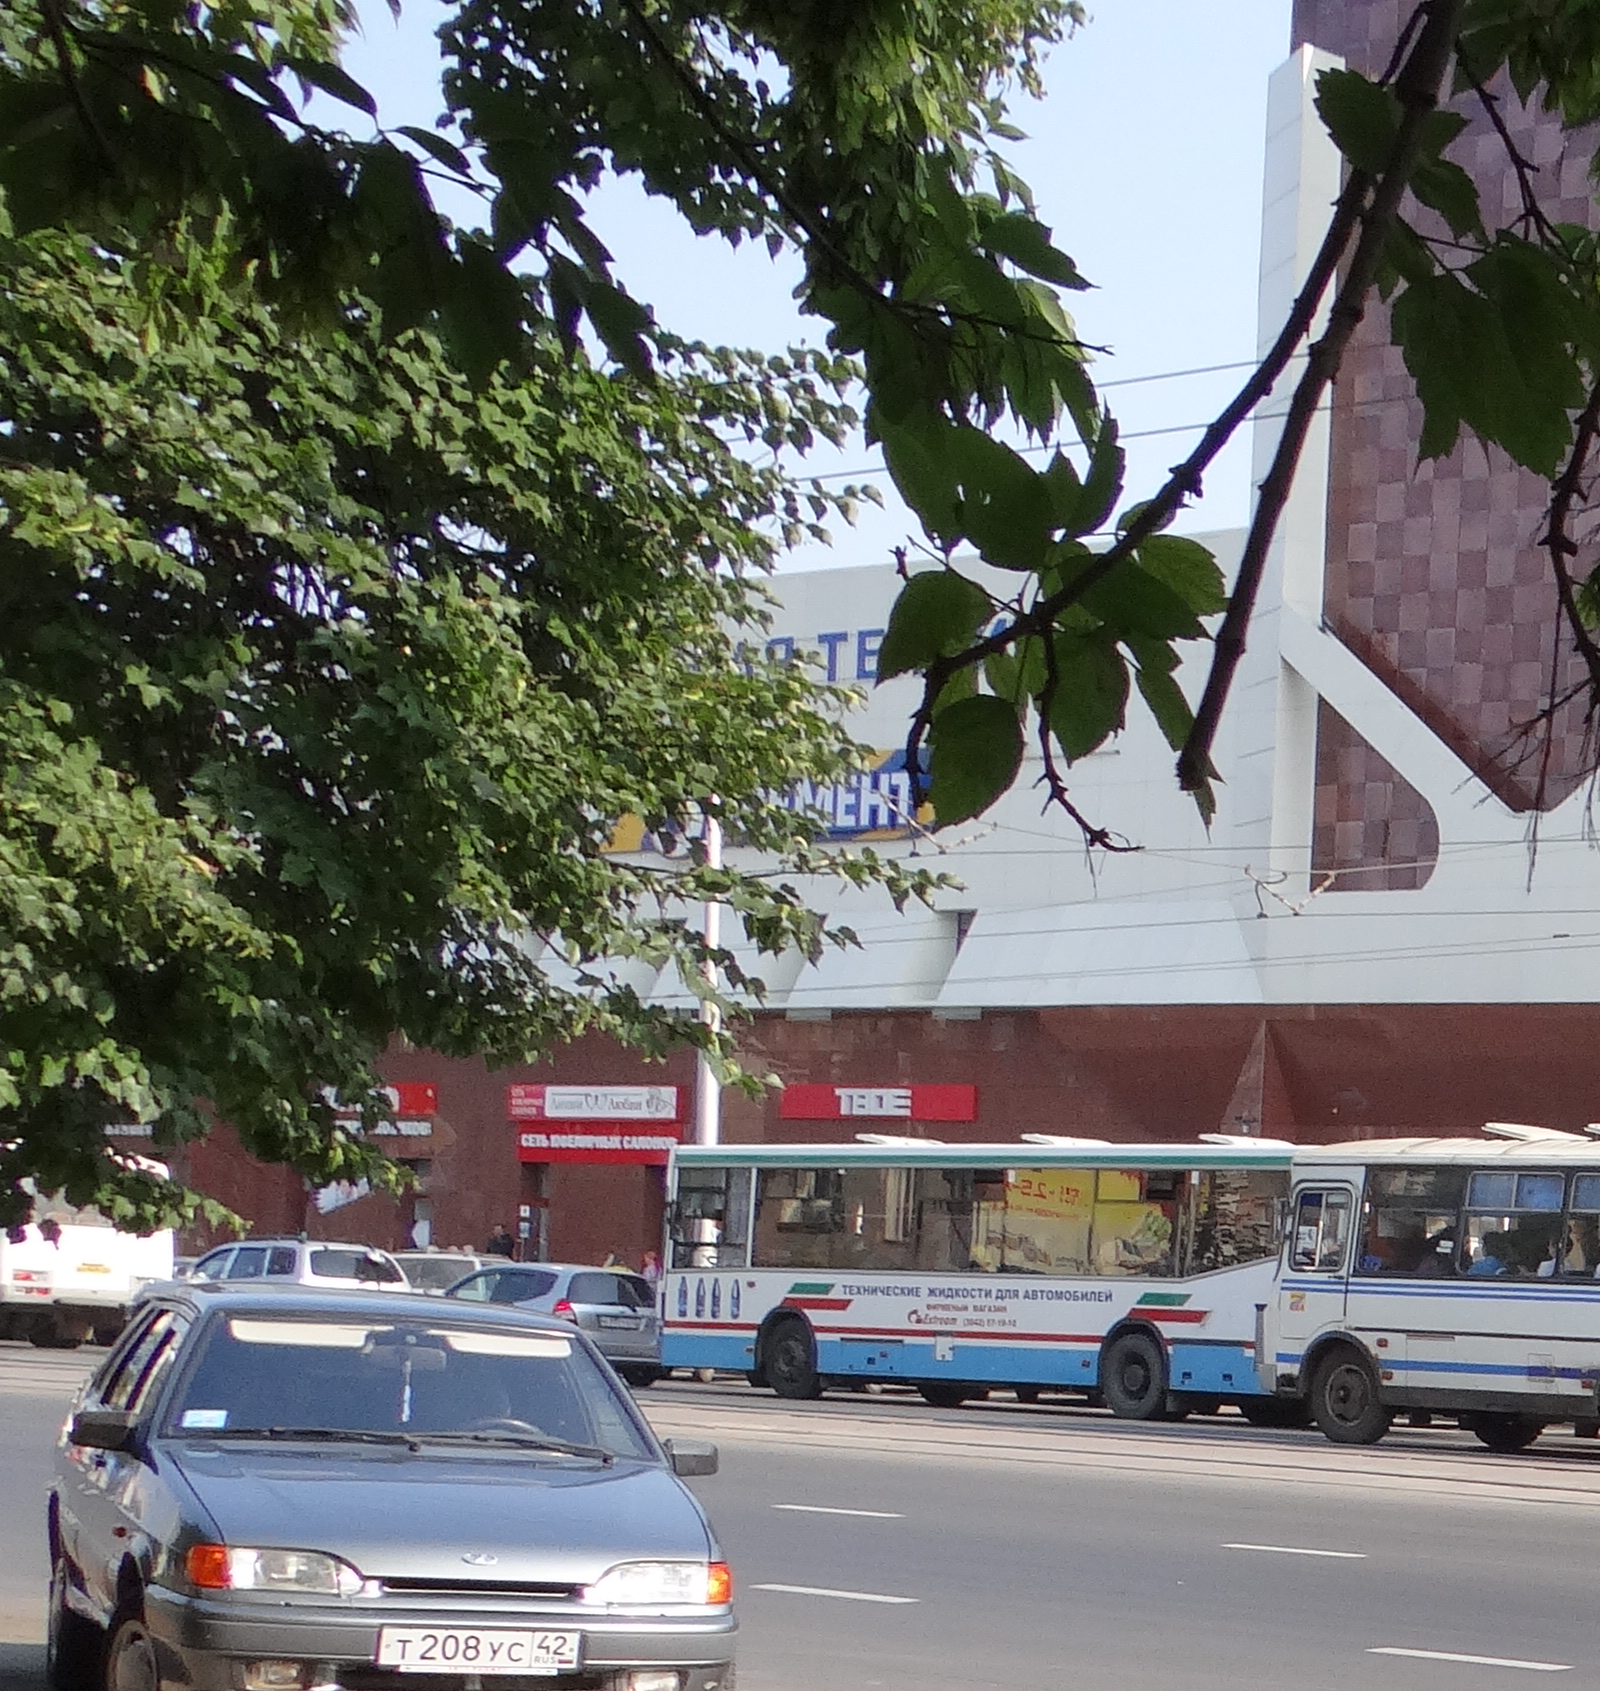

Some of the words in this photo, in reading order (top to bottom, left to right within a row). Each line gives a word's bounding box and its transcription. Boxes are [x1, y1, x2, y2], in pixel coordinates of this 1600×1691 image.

[841, 1284, 922, 1298] ТЕХНИЧЕСКИЕ
[927, 1287, 992, 1300] ЖИДКОСТИ
[995, 1289, 1020, 1302] ДЛЯ
[1022, 1288, 1114, 1304] АВТОМОБИЛЕЙ
[537, 1635, 568, 1656] 42
